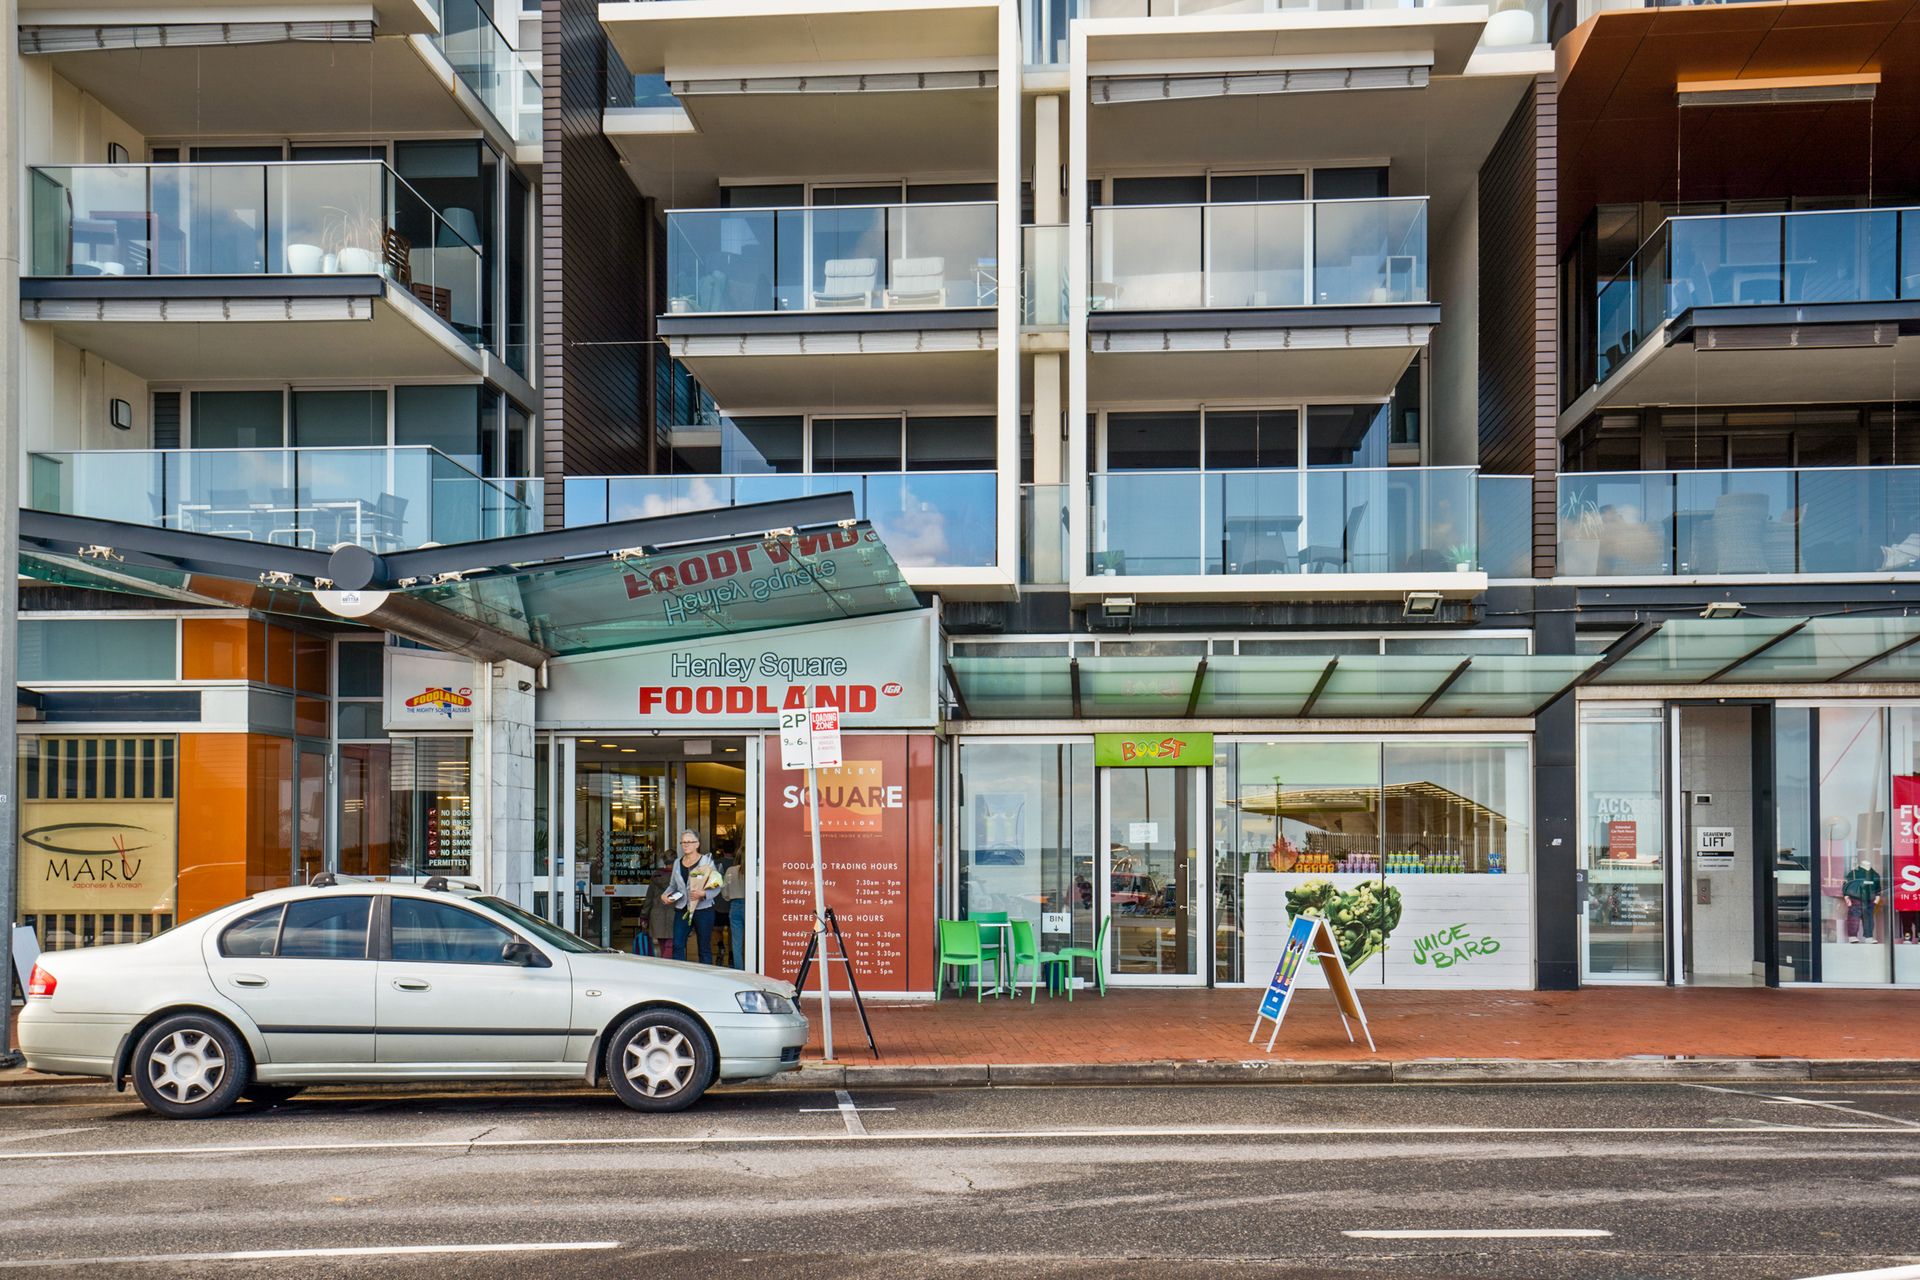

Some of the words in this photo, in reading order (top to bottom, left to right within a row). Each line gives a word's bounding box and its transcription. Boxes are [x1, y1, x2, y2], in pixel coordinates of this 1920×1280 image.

[671, 653, 756, 683] Henley
[760, 652, 848, 683] Square
[413, 690, 465, 706] FOODLAND
[638, 685, 877, 715] FOODLAND
[782, 713, 807, 729] 2P
[812, 712, 837, 723] LOADING
[815, 721, 835, 730] ZONE
[1122, 737, 1187, 762] BOOST
[822, 767, 878, 776] ENLEY
[783, 785, 904, 809] SQUARE
[1702, 837, 1726, 848] LIFT
[46, 858, 142, 881] MARU
[782, 862, 828, 870] FOODLAD
[831, 862, 868, 870] TRADING
[870, 862, 898, 870] HOURS
[887, 880, 901, 888] 9pm
[887, 889, 901, 897] 5pm
[1901, 893, 1910, 901] IN
[782, 914, 815, 922] CENTRE
[856, 914, 885, 922] HOURS
[1049, 915, 1064, 923] BIN
[1413, 922, 1471, 966] JUICE
[782, 949, 804, 957] Friday
[876, 949, 901, 957] 5.30pm
[1431, 936, 1501, 969] BARS
